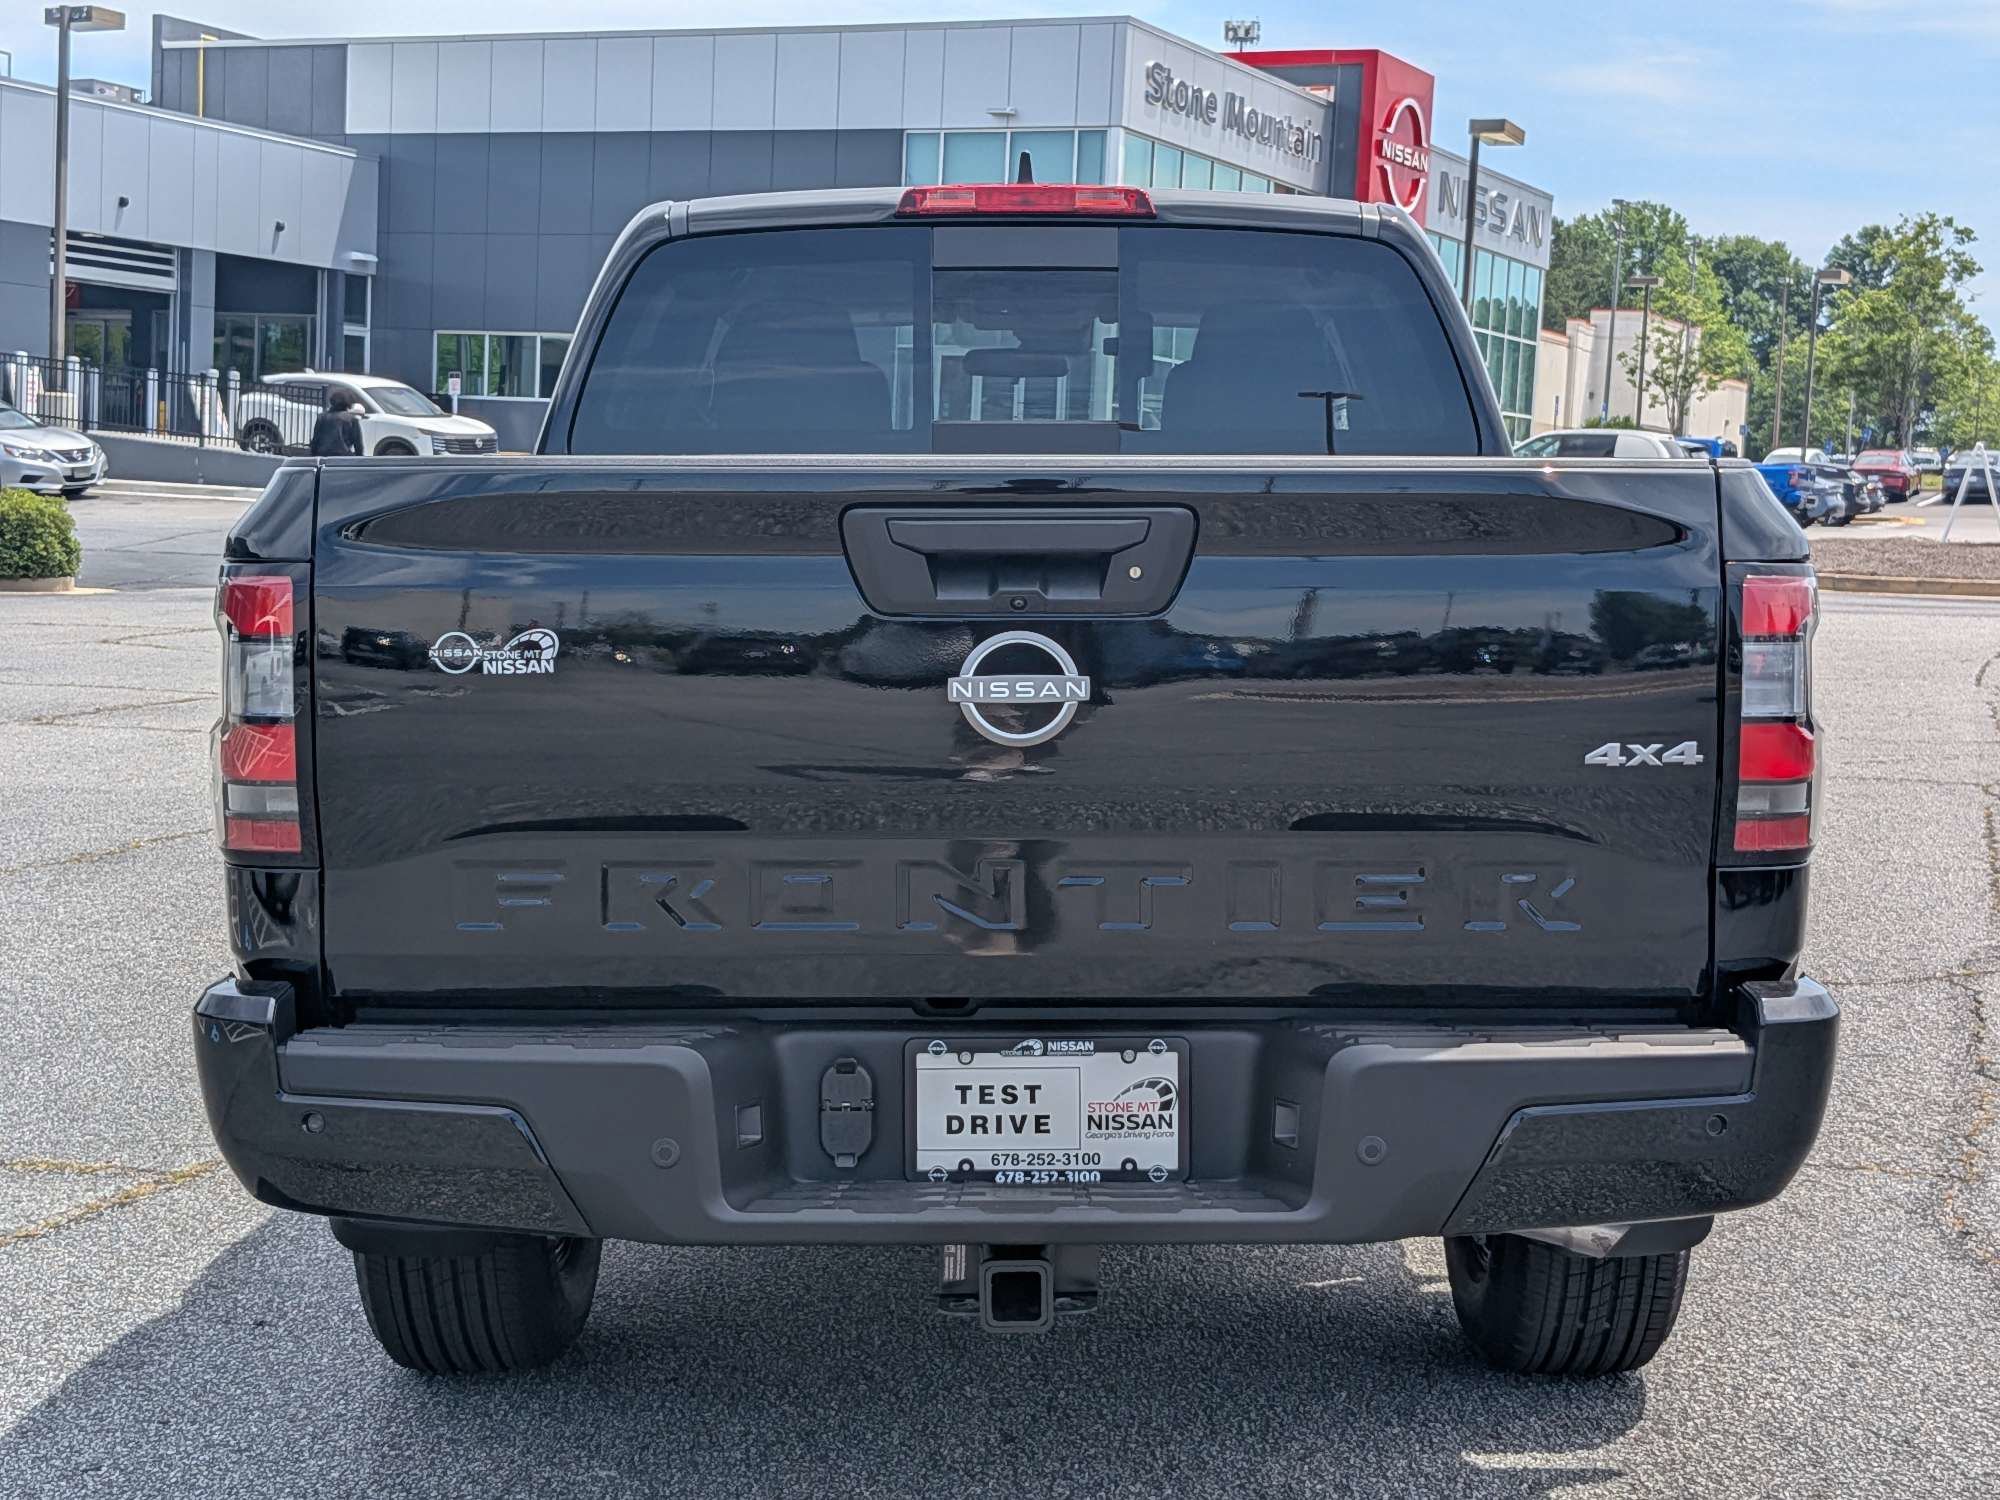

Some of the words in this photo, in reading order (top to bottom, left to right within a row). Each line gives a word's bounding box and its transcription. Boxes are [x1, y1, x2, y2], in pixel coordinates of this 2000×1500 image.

[1145, 61, 1218, 126] Stone
[1222, 91, 1322, 162] Mountain
[1381, 138, 1428, 173] NISSAN
[1438, 171, 1544, 248] NISSAN
[428, 648, 482, 657] NISSAN
[483, 650, 521, 659] STONE
[523, 650, 541, 659] MT
[483, 659, 555, 675] NISSAN
[952, 681, 1086, 698] NISSAN
[453, 860, 1583, 931] FRONTIER
[1047, 1040, 1094, 1051] NISSAN
[955, 1085, 1042, 1104] TEST
[1088, 1102, 1133, 1113] STONE
[1138, 1102, 1158, 1112] MT
[946, 1114, 1051, 1134] DRIVE
[1088, 1114, 1173, 1131] NISSAN
[1085, 1131, 1122, 1140] Georgia's
[1124, 1130, 1151, 1140] Driving
[1152, 1130, 1175, 1138] Force
[991, 1152, 1101, 1166] 678-252-3100
[994, 1171, 1101, 1184] 678-252-3100
